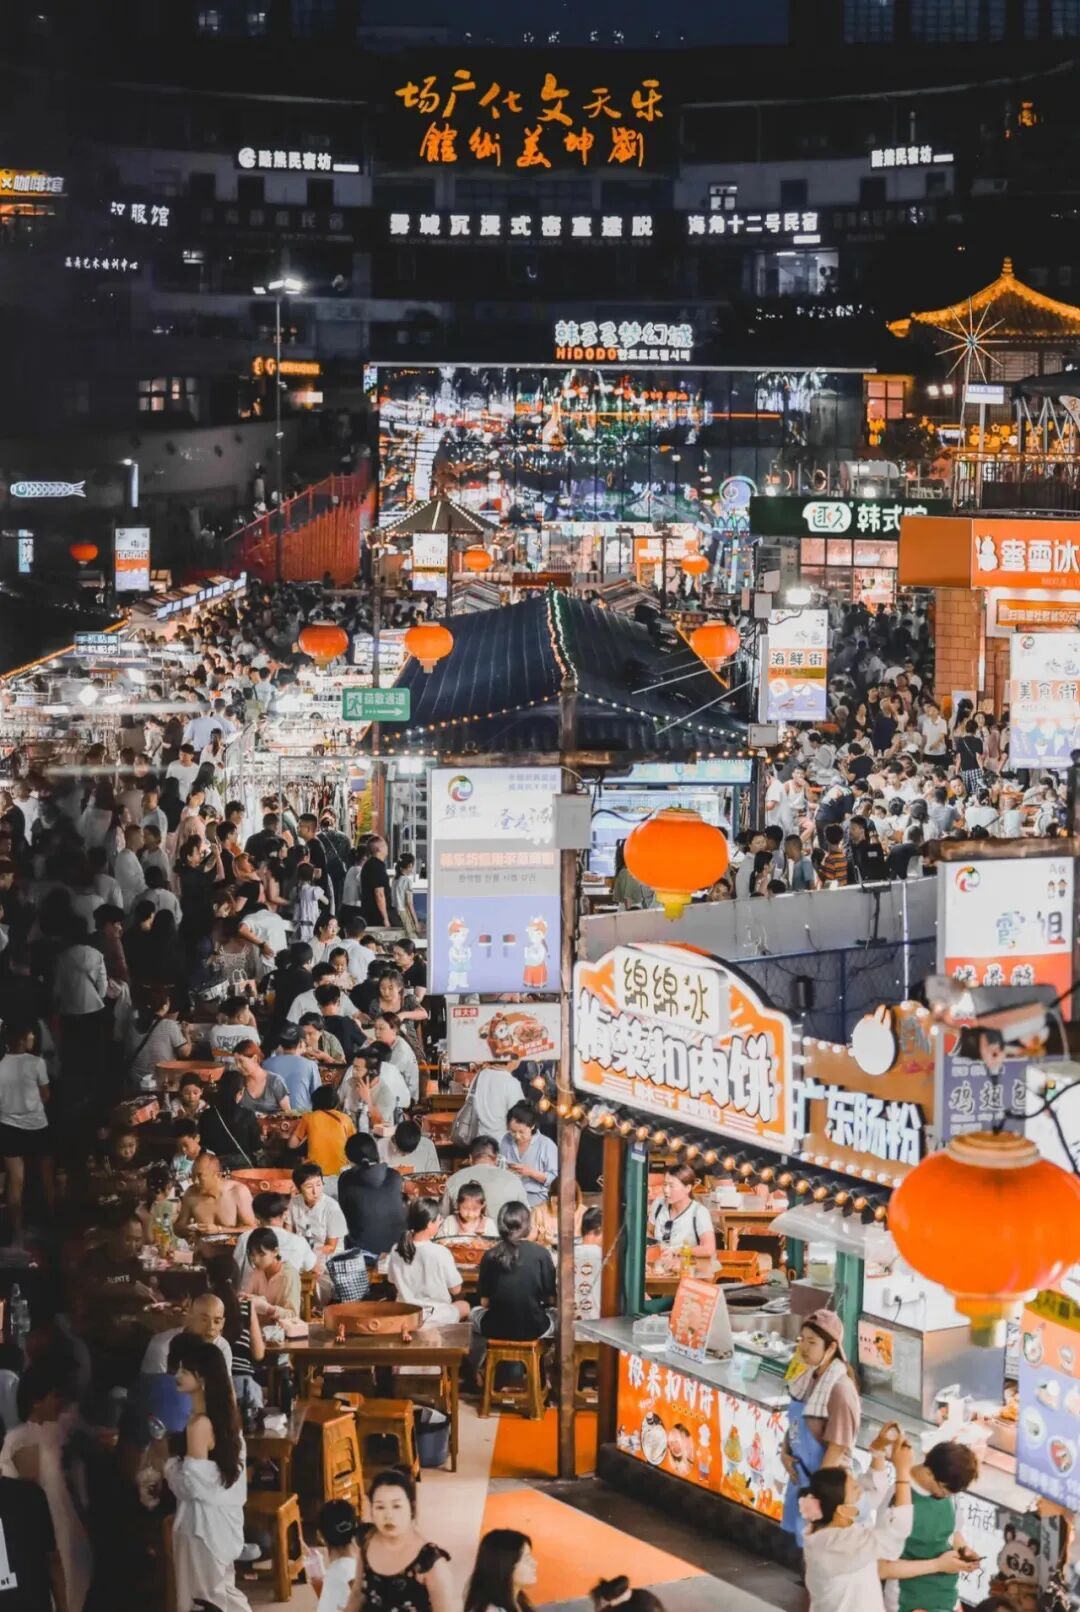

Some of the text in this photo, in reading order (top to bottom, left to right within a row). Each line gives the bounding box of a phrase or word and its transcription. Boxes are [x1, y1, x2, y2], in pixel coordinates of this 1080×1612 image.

[687, 211, 818, 235] 海角十二号民宿
[554, 319, 694, 349] 韩多多梦幻城
[791, 1077, 923, 1168] 广东肠粉
